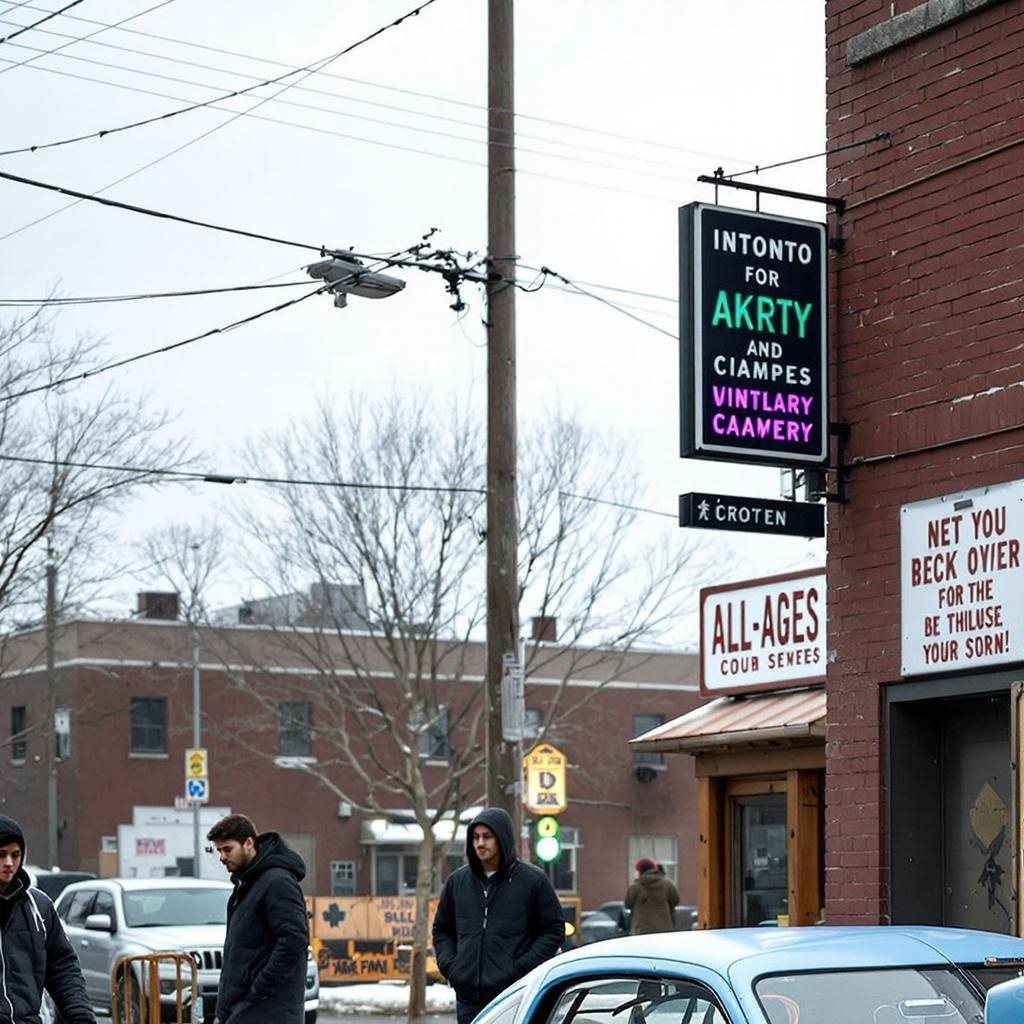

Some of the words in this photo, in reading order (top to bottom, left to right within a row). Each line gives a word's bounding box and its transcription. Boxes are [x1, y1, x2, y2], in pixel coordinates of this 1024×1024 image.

[713, 229, 812, 265] INTONTO
[745, 266, 780, 288] FOR
[711, 290, 813, 338] AKRTY
[747, 340, 783, 359] AND
[713, 356, 811, 385] CIAMPES
[712, 386, 813, 416] VINTLARY
[712, 413, 813, 443] CAAMERY
[928, 515, 963, 549] NET
[971, 506, 1006, 540] YOU
[912, 550, 959, 587] BECK
[939, 585, 963, 609] FOR
[968, 579, 993, 604] THE
[712, 587, 819, 655] ALL-AGES
[924, 615, 940, 637] BE
[923, 640, 958, 664] YOUR
[965, 631, 1009, 661] SORN!
